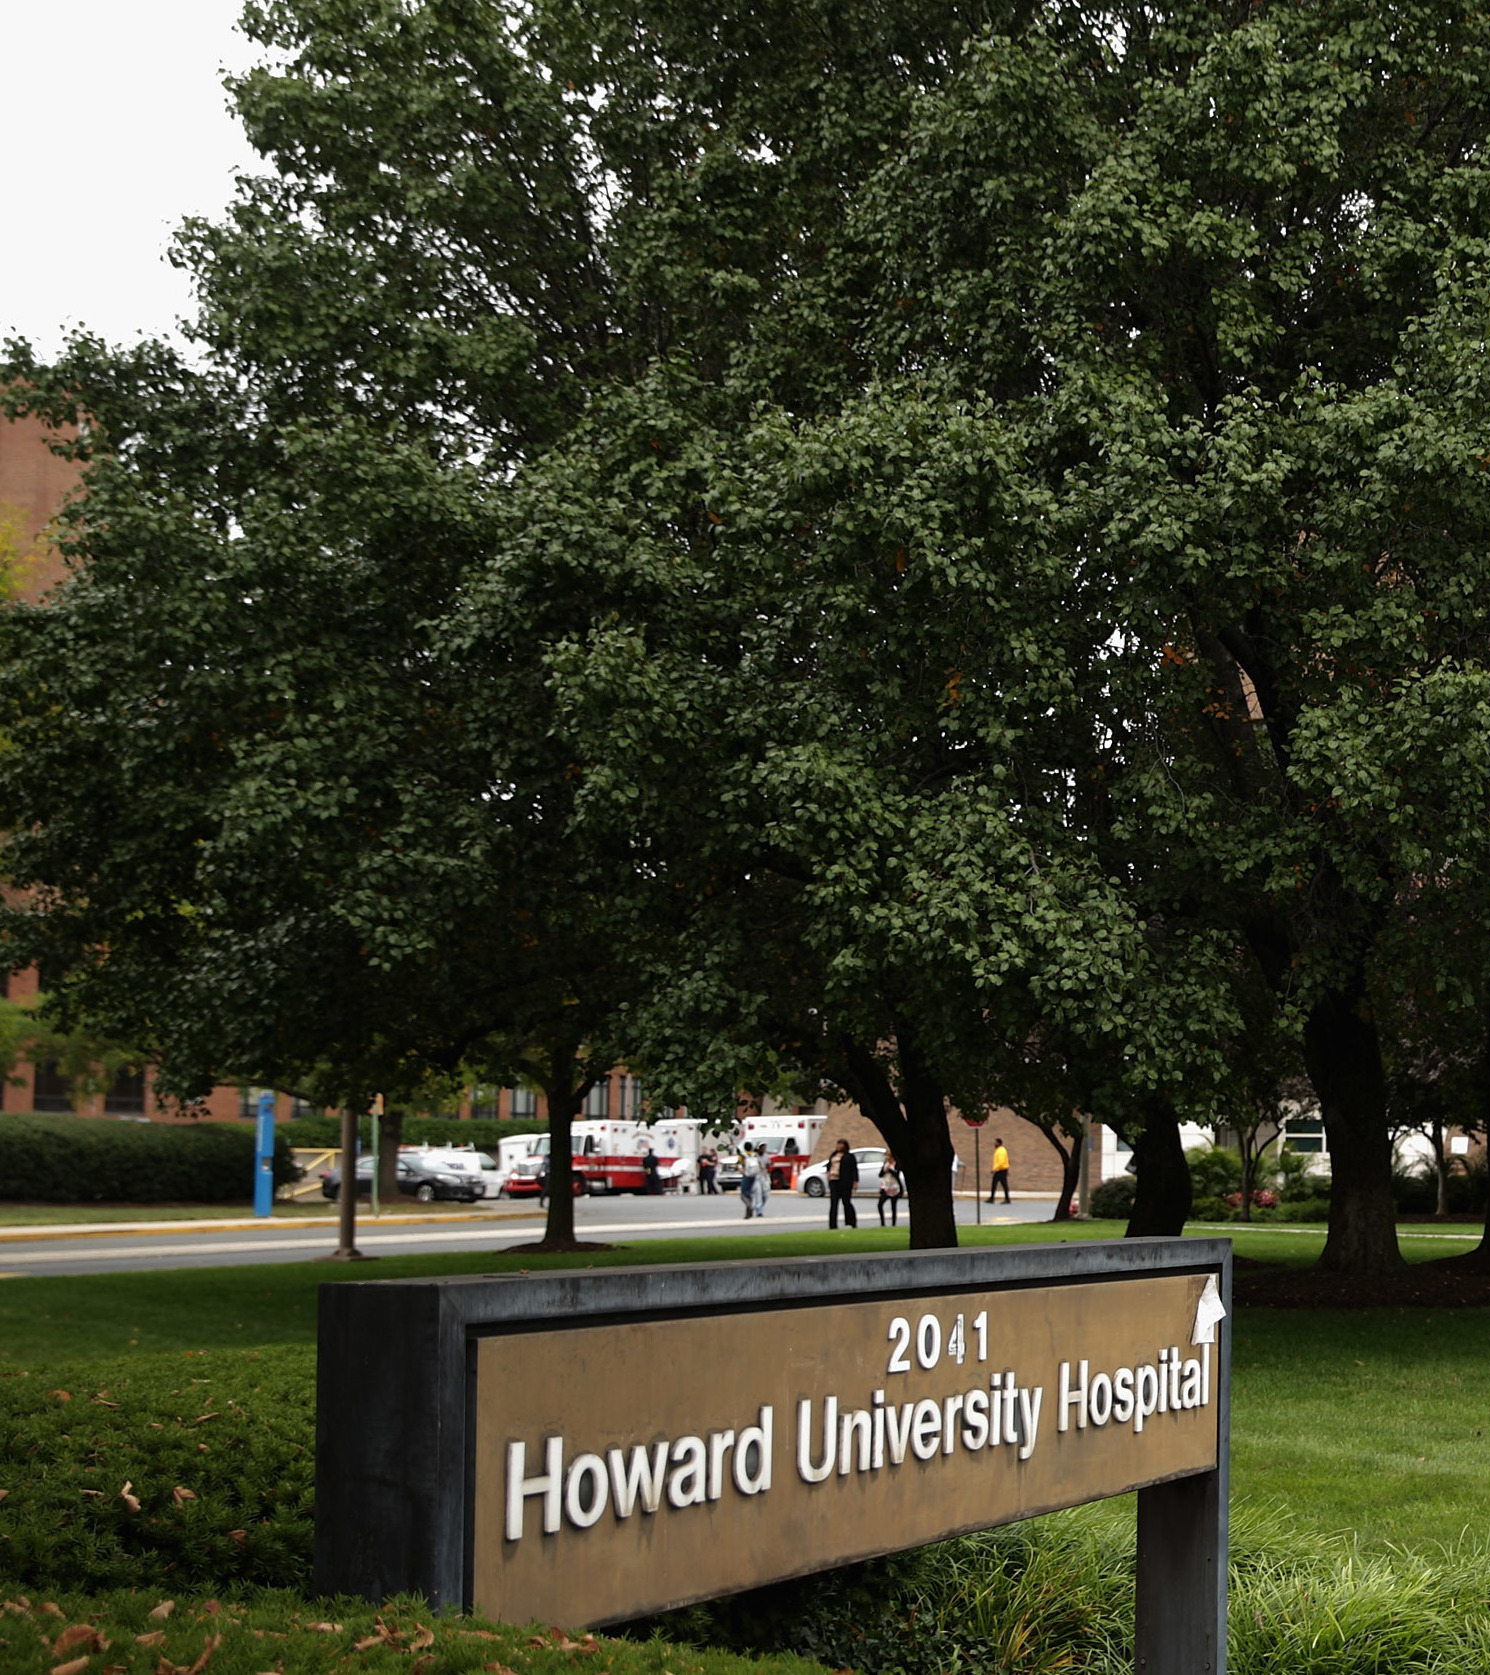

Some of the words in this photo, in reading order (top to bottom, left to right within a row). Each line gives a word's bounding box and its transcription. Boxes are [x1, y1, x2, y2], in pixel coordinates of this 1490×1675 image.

[887, 1310, 988, 1373] 2041
[505, 1405, 774, 1540] Howard
[796, 1371, 1043, 1483] University
[1057, 1342, 1211, 1433] Hospital
